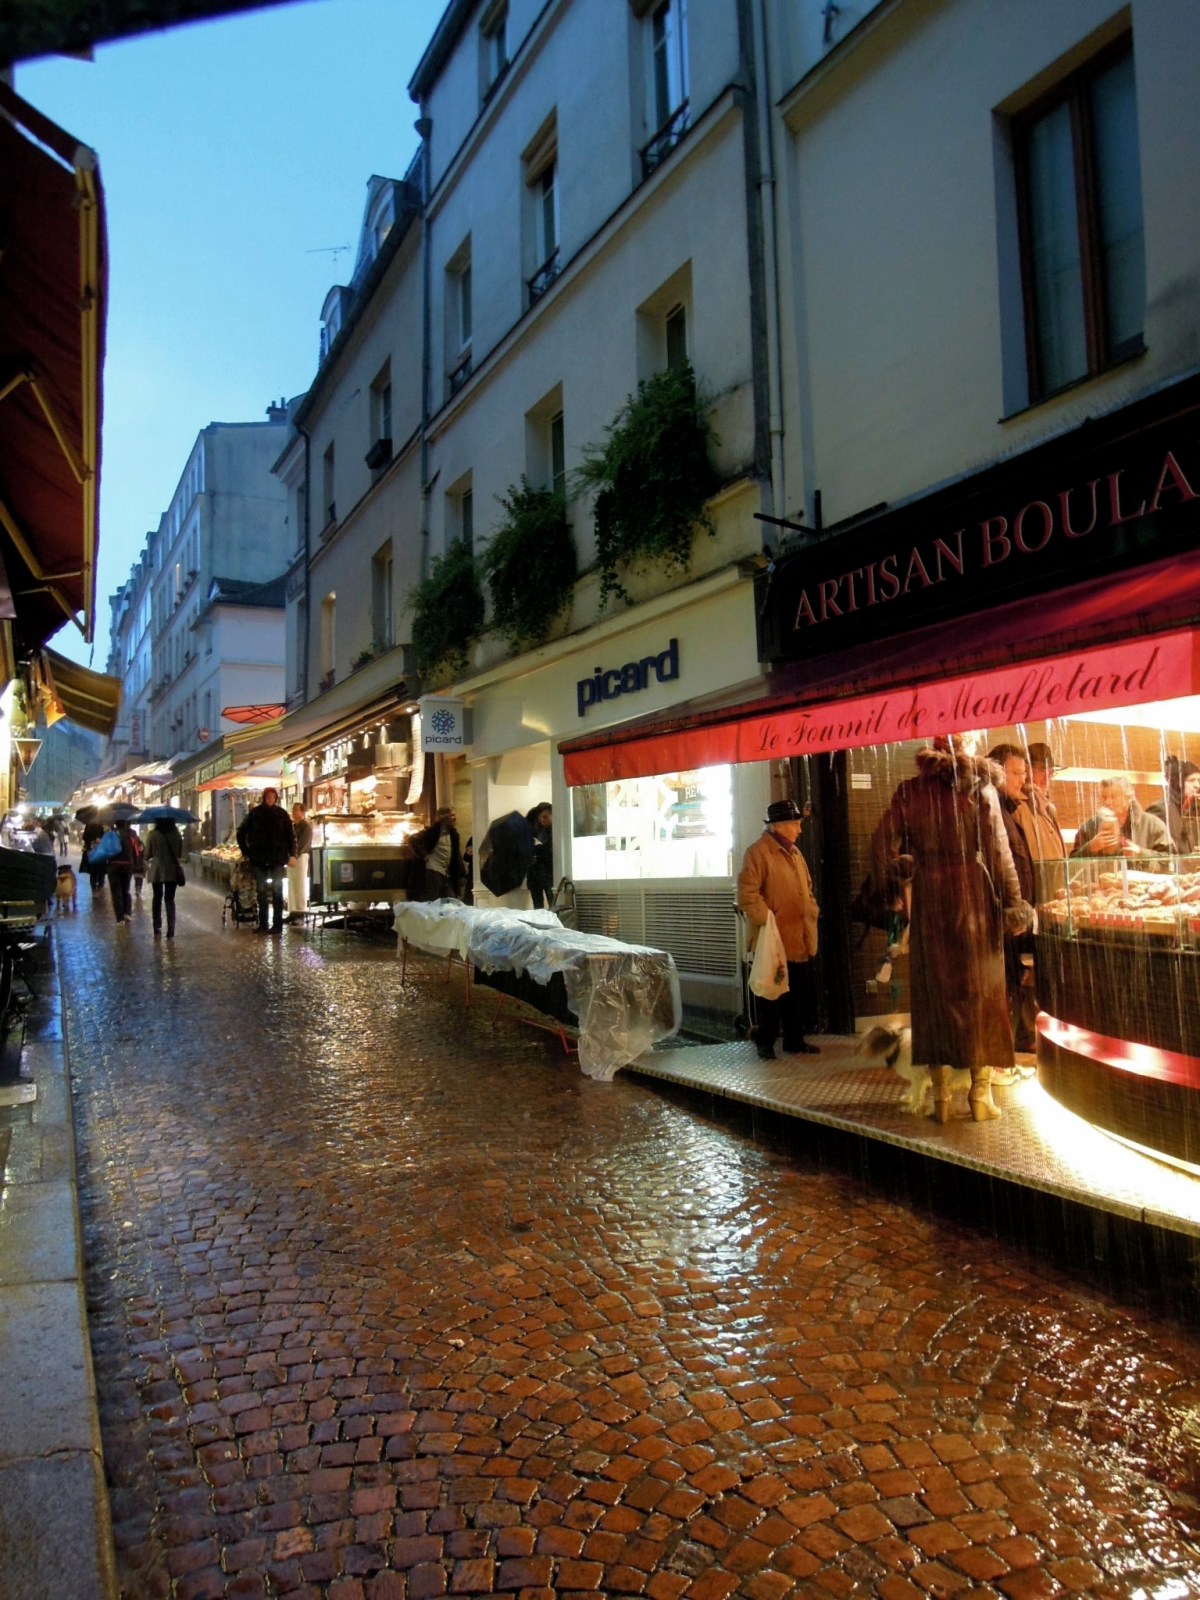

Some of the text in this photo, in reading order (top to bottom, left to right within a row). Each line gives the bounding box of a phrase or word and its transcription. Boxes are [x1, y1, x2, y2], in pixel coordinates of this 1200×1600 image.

[793, 451, 1200, 631] ARTISAN BOULA
[577, 638, 679, 717] picard
[758, 647, 1163, 752] Le Fournil de Mouffetard
[425, 734, 462, 745] picard
